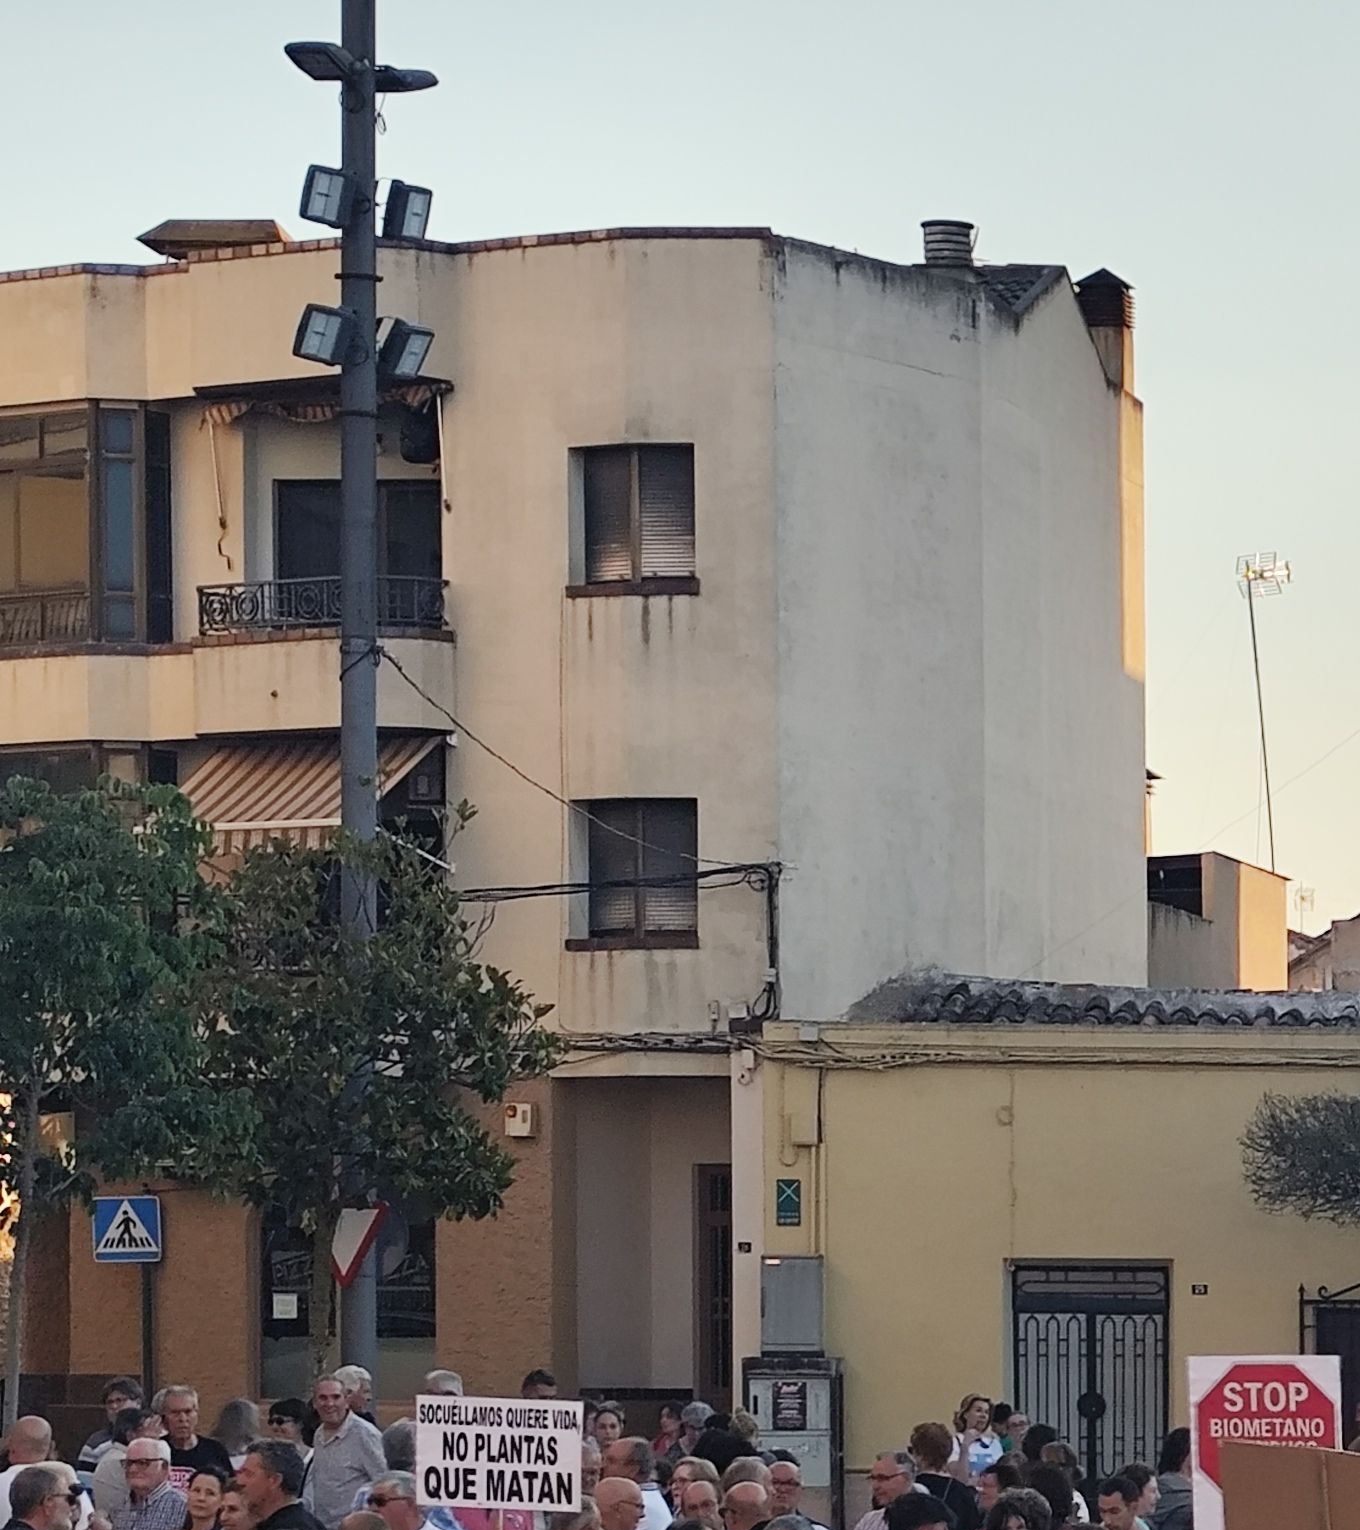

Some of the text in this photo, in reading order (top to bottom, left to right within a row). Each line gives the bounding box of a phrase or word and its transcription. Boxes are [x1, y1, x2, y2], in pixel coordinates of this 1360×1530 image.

[1223, 1381, 1309, 1412] STOP
[419, 1401, 581, 1435] SOCUÉLLAMOS QUIERE VIDA,
[1210, 1417, 1325, 1438] BIOMETANO
[442, 1431, 558, 1466] NO PLANTAS
[424, 1465, 573, 1505] QUE MATAN
